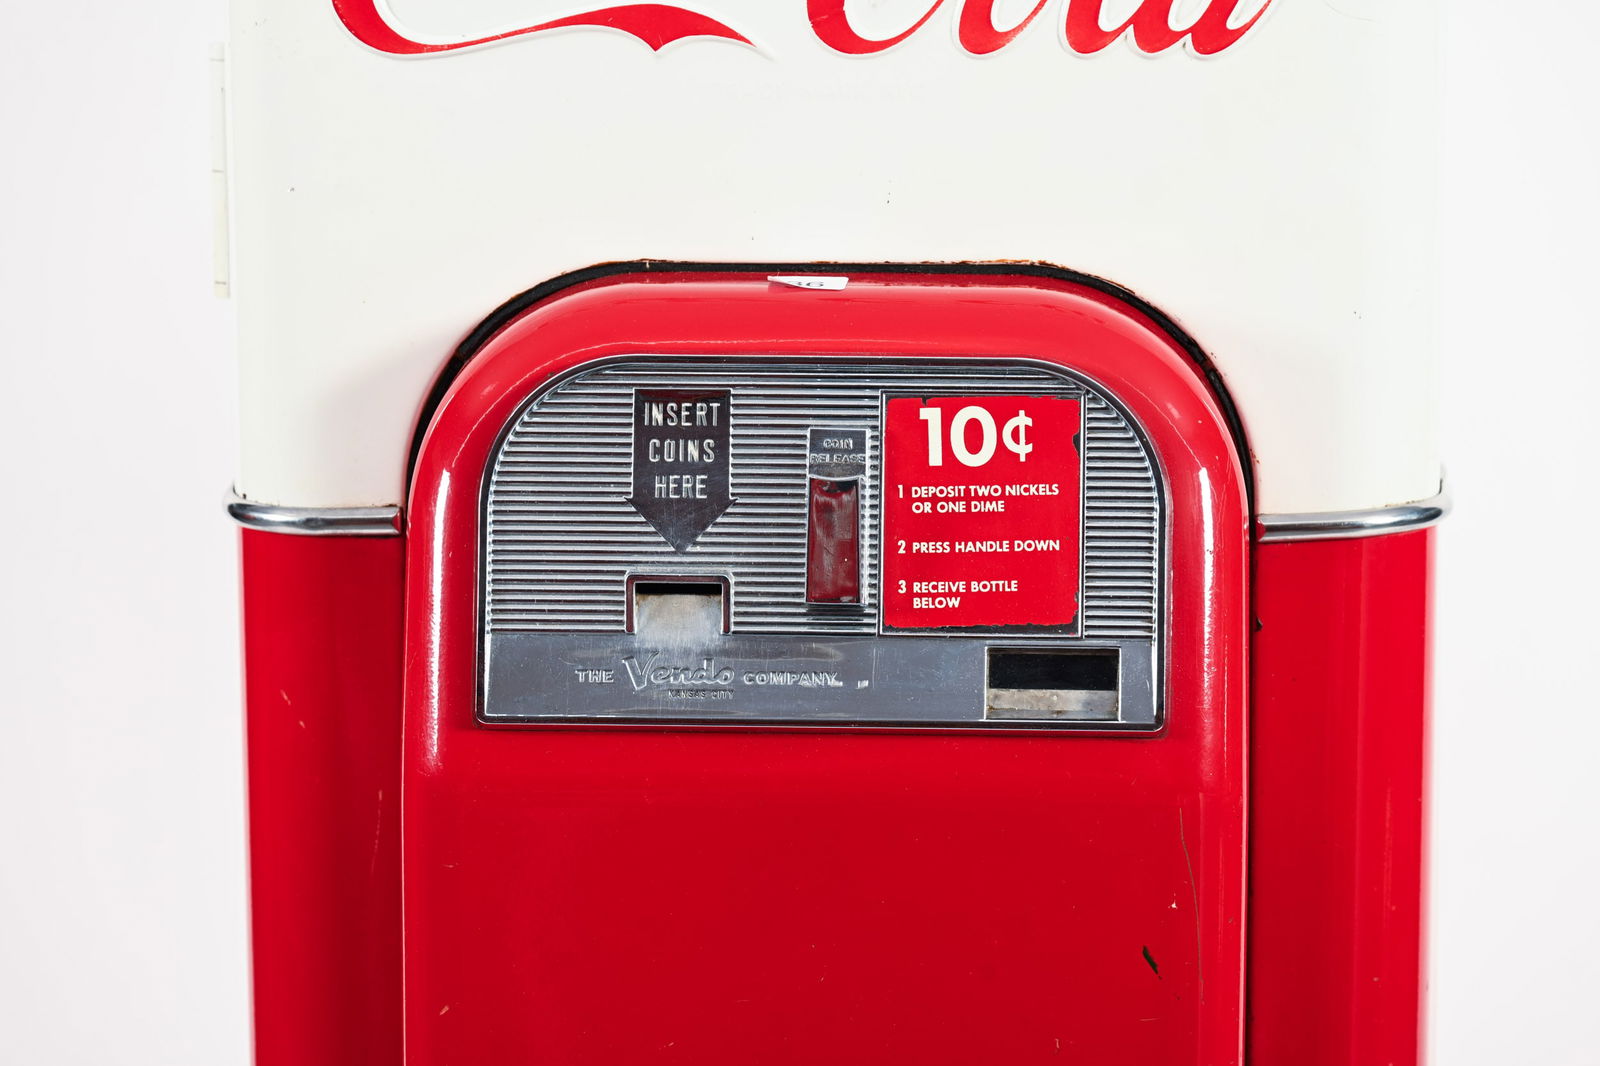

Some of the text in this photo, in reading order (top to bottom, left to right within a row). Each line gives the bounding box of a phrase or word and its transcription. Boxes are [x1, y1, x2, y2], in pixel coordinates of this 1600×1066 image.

[644, 402, 721, 427] INSERT
[822, 437, 853, 450] COIN
[919, 405, 1033, 468] 10¢
[648, 438, 715, 463] COINS
[809, 453, 866, 464] RELEASE
[654, 475, 708, 499] HERE
[897, 483, 1060, 499] 1 DEPOSIT TWO NICKELS
[911, 500, 1005, 514] OR ONE DIME
[897, 539, 1060, 554] 2 PRESS HANDLE DOWN
[897, 580, 1018, 594] 3 RECEIVE BOTTLE
[912, 596, 961, 609] BELOW
[575, 650, 838, 691] THE Vendo COMPANY
[667, 689, 736, 699] KANSAS CITY
